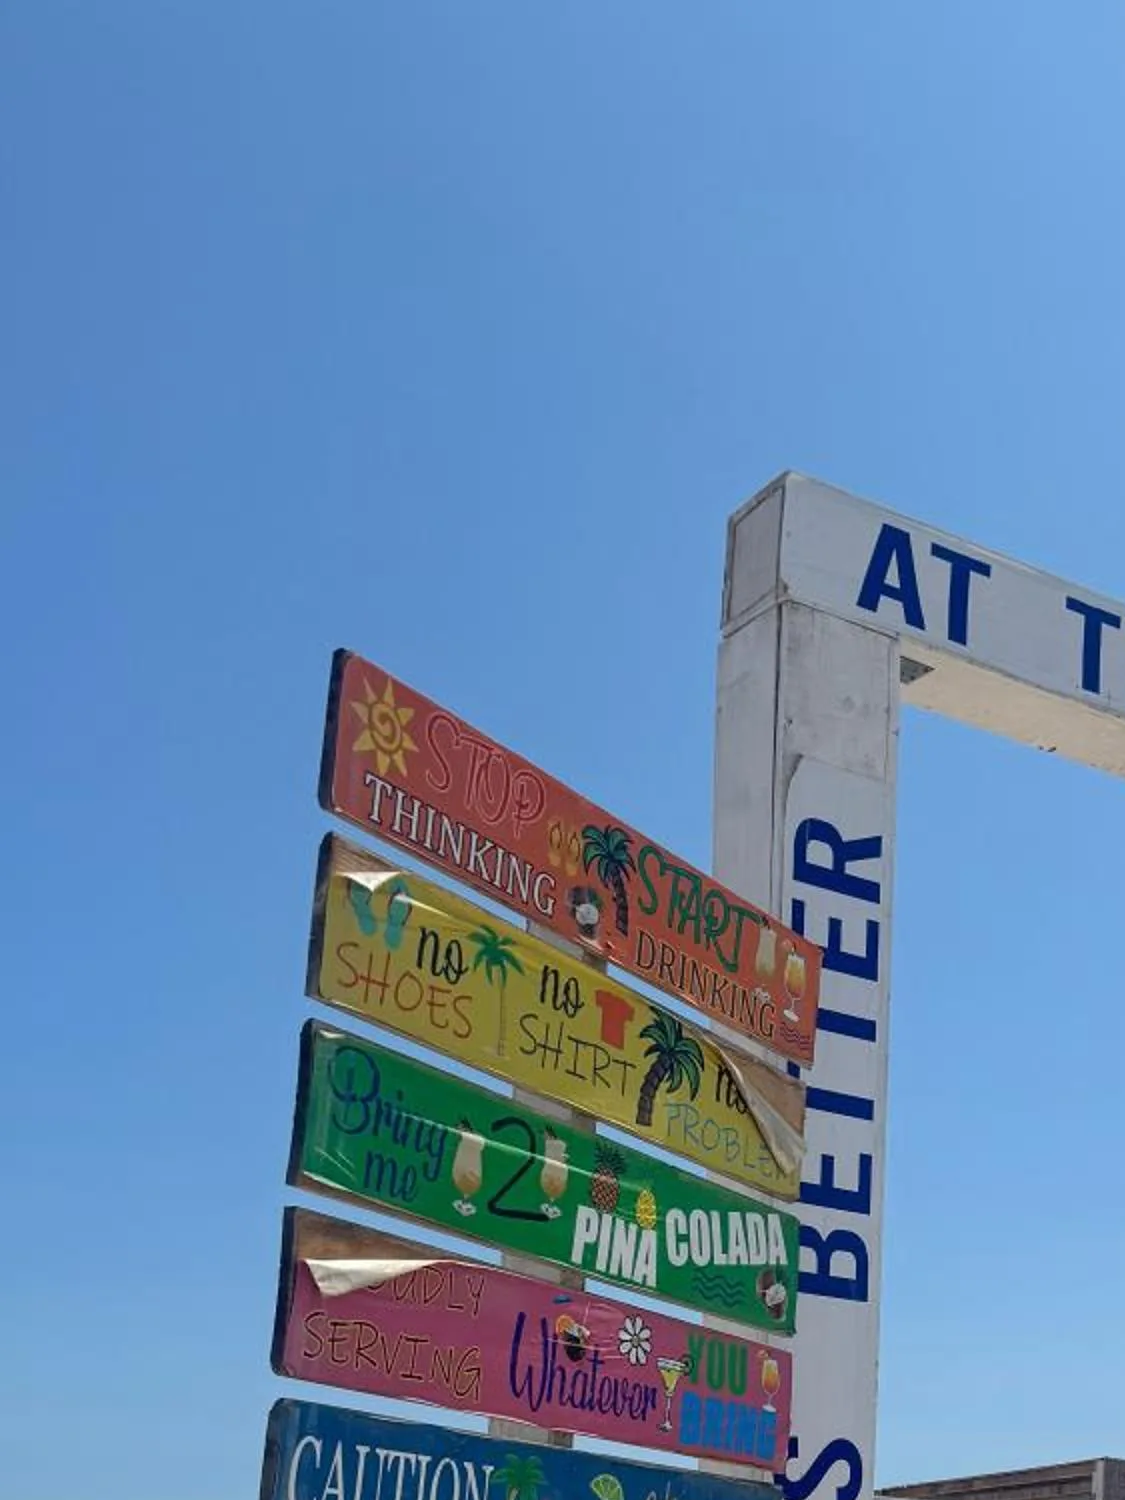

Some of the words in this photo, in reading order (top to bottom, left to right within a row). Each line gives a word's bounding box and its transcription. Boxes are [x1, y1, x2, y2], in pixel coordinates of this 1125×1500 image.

[857, 523, 991, 647] AT
[423, 712, 547, 837] STOP
[637, 844, 764, 973] START
[365, 771, 557, 919] THINKING
[635, 928, 777, 1040] DRINKING
[335, 941, 473, 1039] SHOES
[519, 1013, 637, 1096] SHIRT
[416, 925, 469, 985] no
[540, 964, 585, 1018] no
[364, 1150, 418, 1203] me
[487, 1116, 550, 1222] 2
[571, 1204, 657, 1288] PINA
[665, 1207, 788, 1267] COLADA
[303, 1311, 483, 1401] SERVING
[509, 1311, 658, 1421] Whatever
[683, 1329, 748, 1397] YOU
